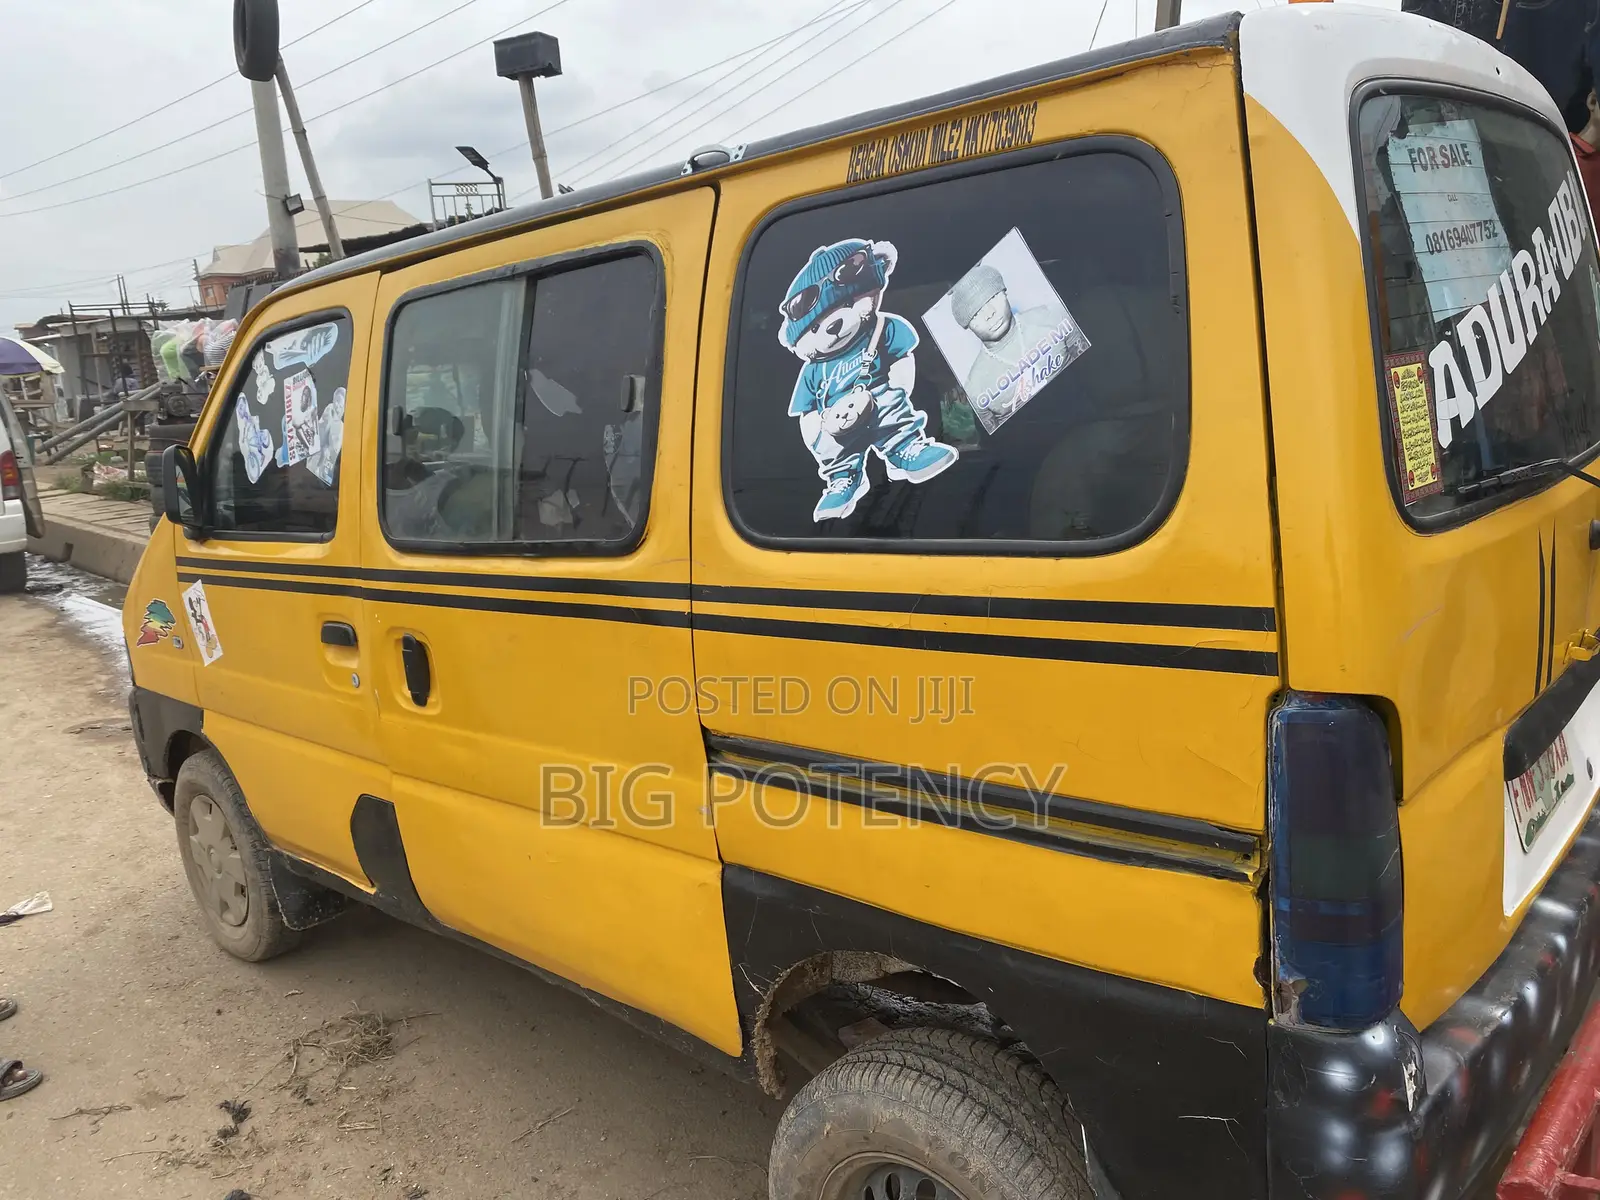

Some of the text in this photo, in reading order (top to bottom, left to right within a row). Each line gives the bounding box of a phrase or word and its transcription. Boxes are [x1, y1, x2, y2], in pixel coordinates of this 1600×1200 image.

[888, 126, 930, 175] OSHODI
[1407, 143, 1473, 173] FOR SALE
[1425, 219, 1499, 256] 08169407752
[977, 338, 1052, 409] OLOLADE
